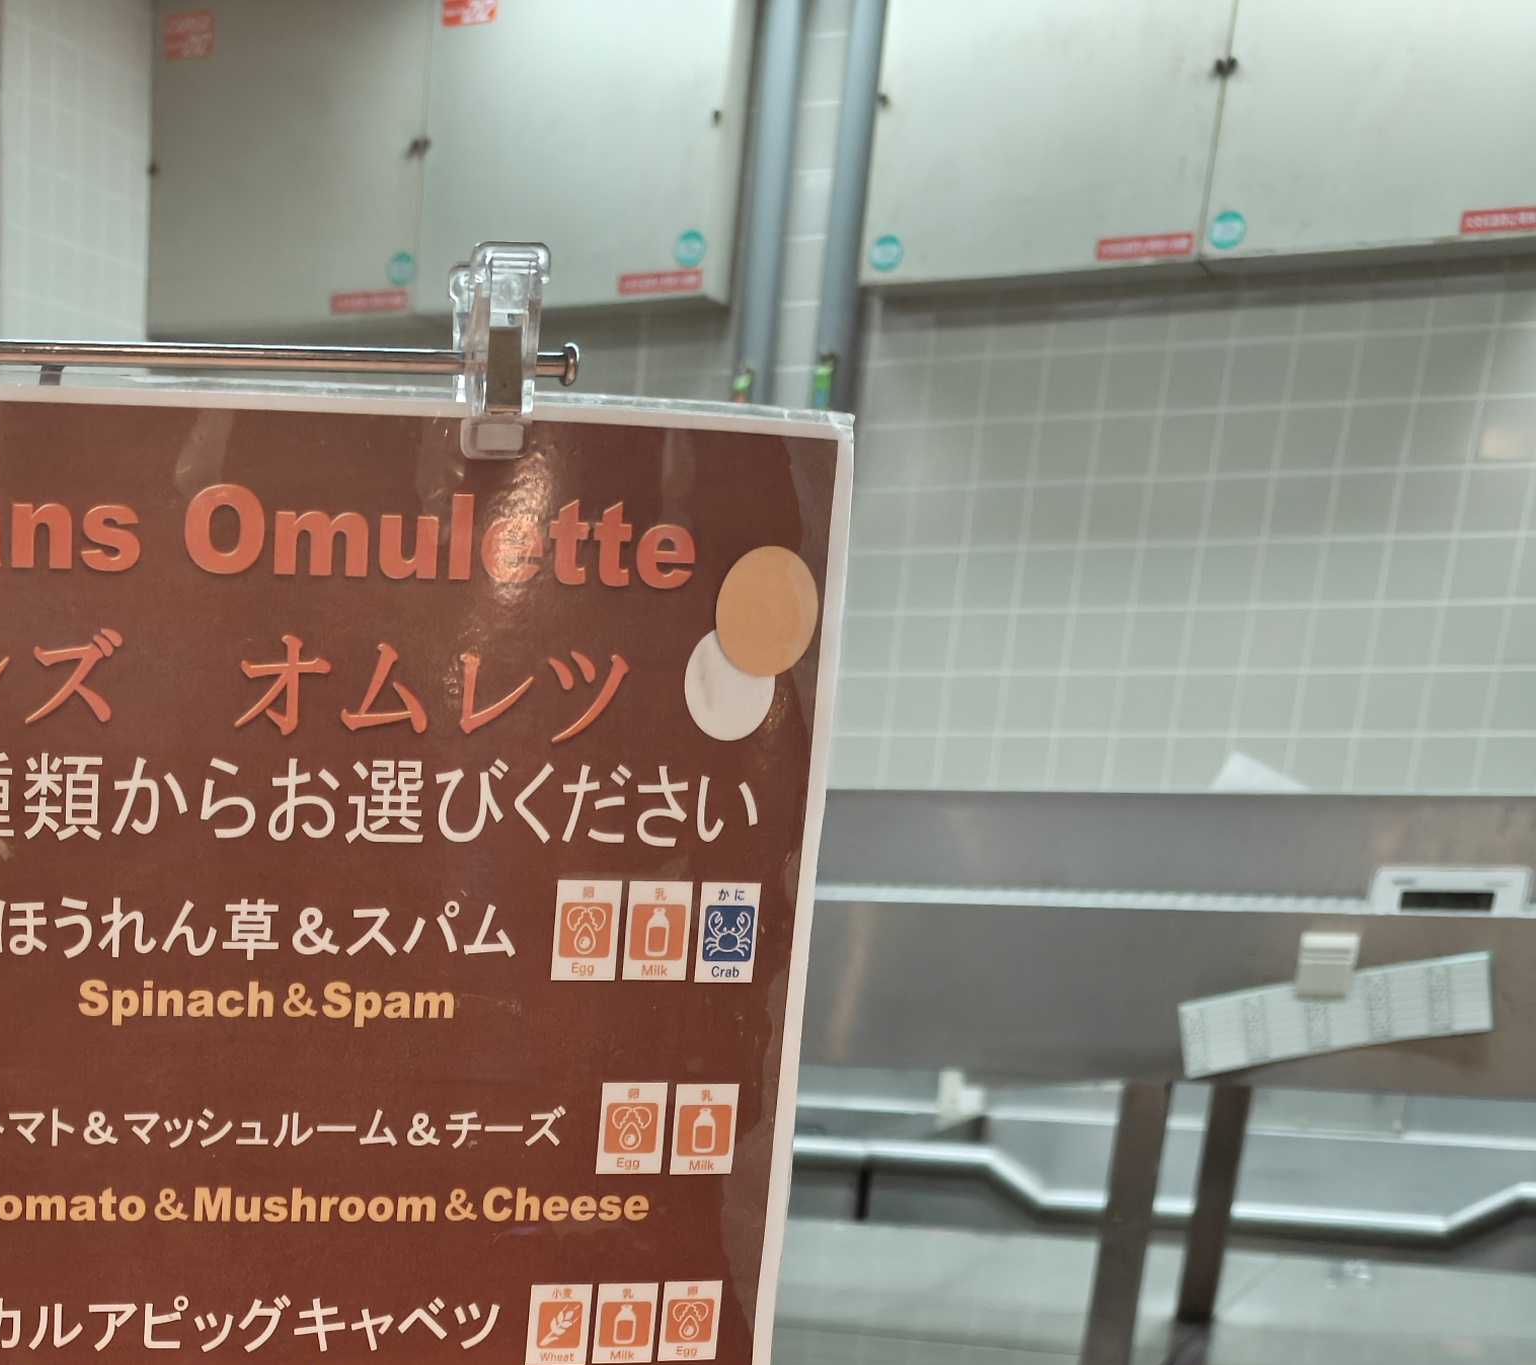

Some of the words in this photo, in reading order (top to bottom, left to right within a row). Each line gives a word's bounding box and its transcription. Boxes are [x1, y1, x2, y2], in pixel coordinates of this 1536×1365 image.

[185, 484, 695, 588] Omulette
[234, 634, 630, 743] オムレツ
[718, 888, 746, 901] かに
[571, 962, 595, 976] Egg
[641, 964, 668, 978] Milk
[711, 965, 740, 979] Crab
[616, 1157, 641, 1171] Egg
[688, 1159, 715, 1172] Milk
[540, 1352, 576, 1363] Wheat
[609, 1349, 635, 1361] Milk
[675, 1345, 698, 1358] Egg
